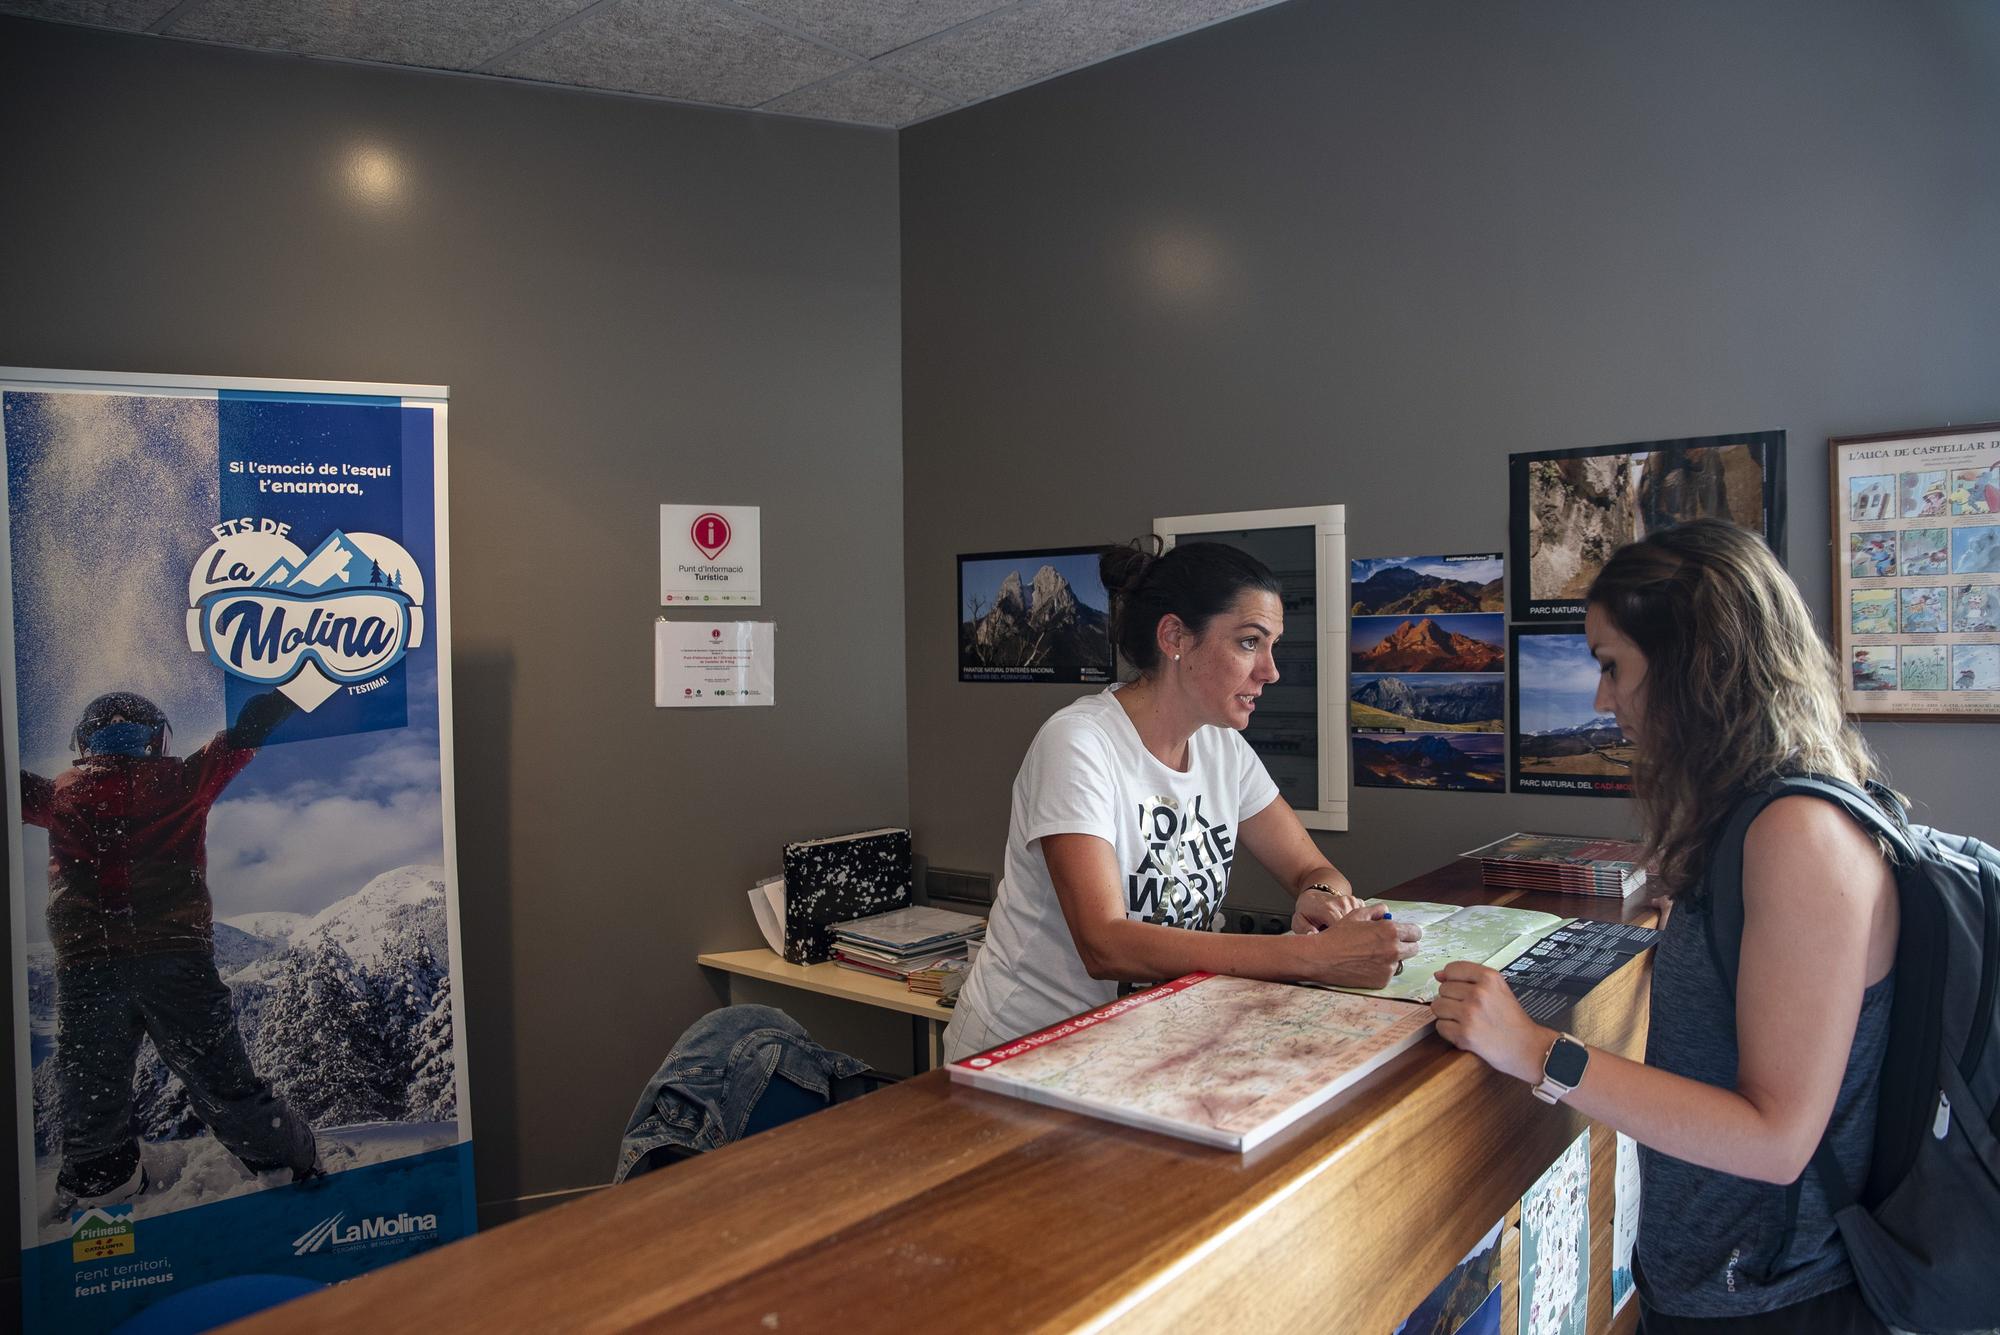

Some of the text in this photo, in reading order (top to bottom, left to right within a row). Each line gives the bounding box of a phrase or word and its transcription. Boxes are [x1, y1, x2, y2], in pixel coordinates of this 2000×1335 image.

[1894, 447, 1909, 457] DE
[1912, 440, 1985, 456] CASTELLAR
[229, 461, 392, 478] Si l'emoció de l'esquí
[259, 479, 364, 495] t'enamora,
[211, 518, 292, 541] ETS DE
[205, 548, 256, 585] La
[678, 564, 744, 573] Punt d'Informació
[694, 573, 729, 581] Turística
[1530, 606, 1587, 614] PARC NATURAL
[215, 600, 395, 669] Molina
[347, 675, 390, 696] T'ESTIMA!
[1520, 779, 1540, 787] PARC
[1541, 780, 1576, 788] NATURAL
[1577, 781, 1593, 789] DEL
[992, 1042, 1030, 1059] Parc
[1029, 1025, 1075, 1047] Natural
[1075, 1016, 1098, 1030] del
[80, 1225, 127, 1240] Pirineus
[75, 1256, 172, 1283] Fent territori,
[75, 1273, 174, 1298] fent Pirineus
